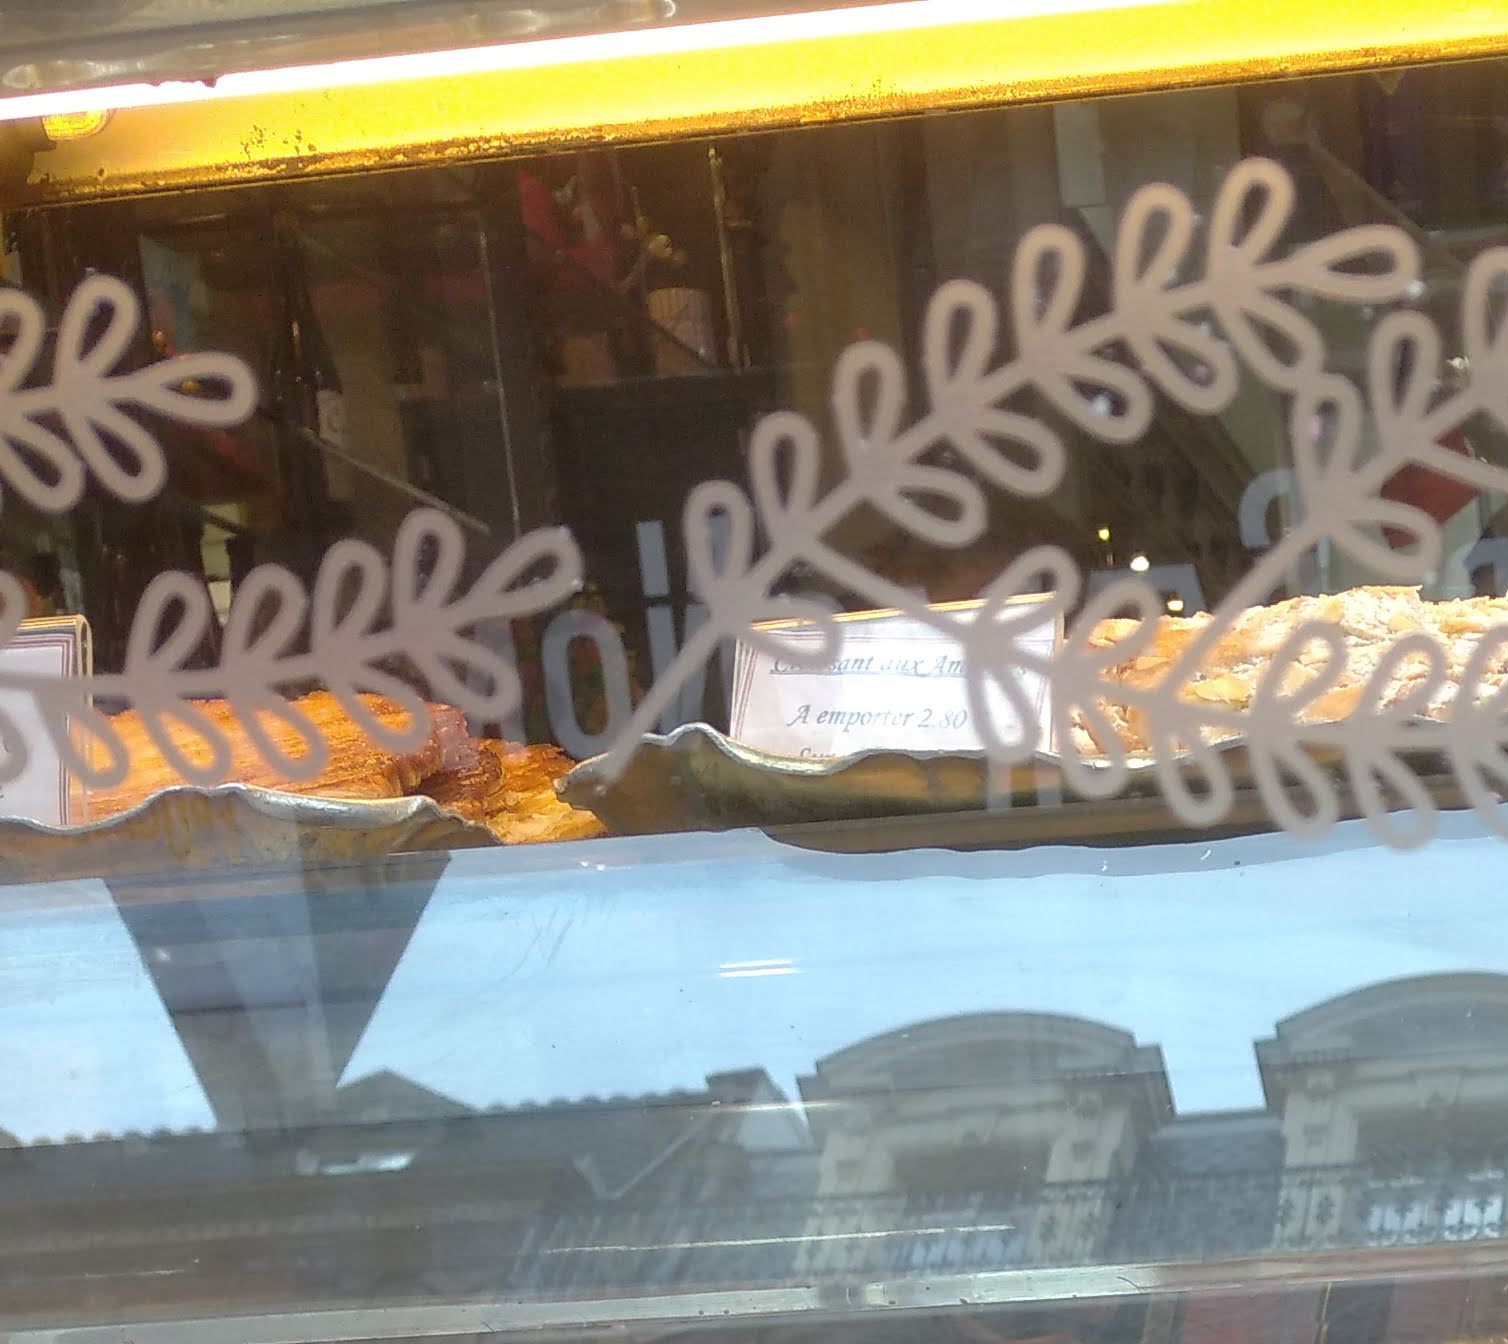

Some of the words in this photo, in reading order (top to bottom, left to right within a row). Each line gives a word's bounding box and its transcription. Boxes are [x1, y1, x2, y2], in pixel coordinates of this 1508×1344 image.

[786, 703, 811, 727] A
[816, 707, 915, 733] emporter
[917, 707, 968, 730] 2.80
